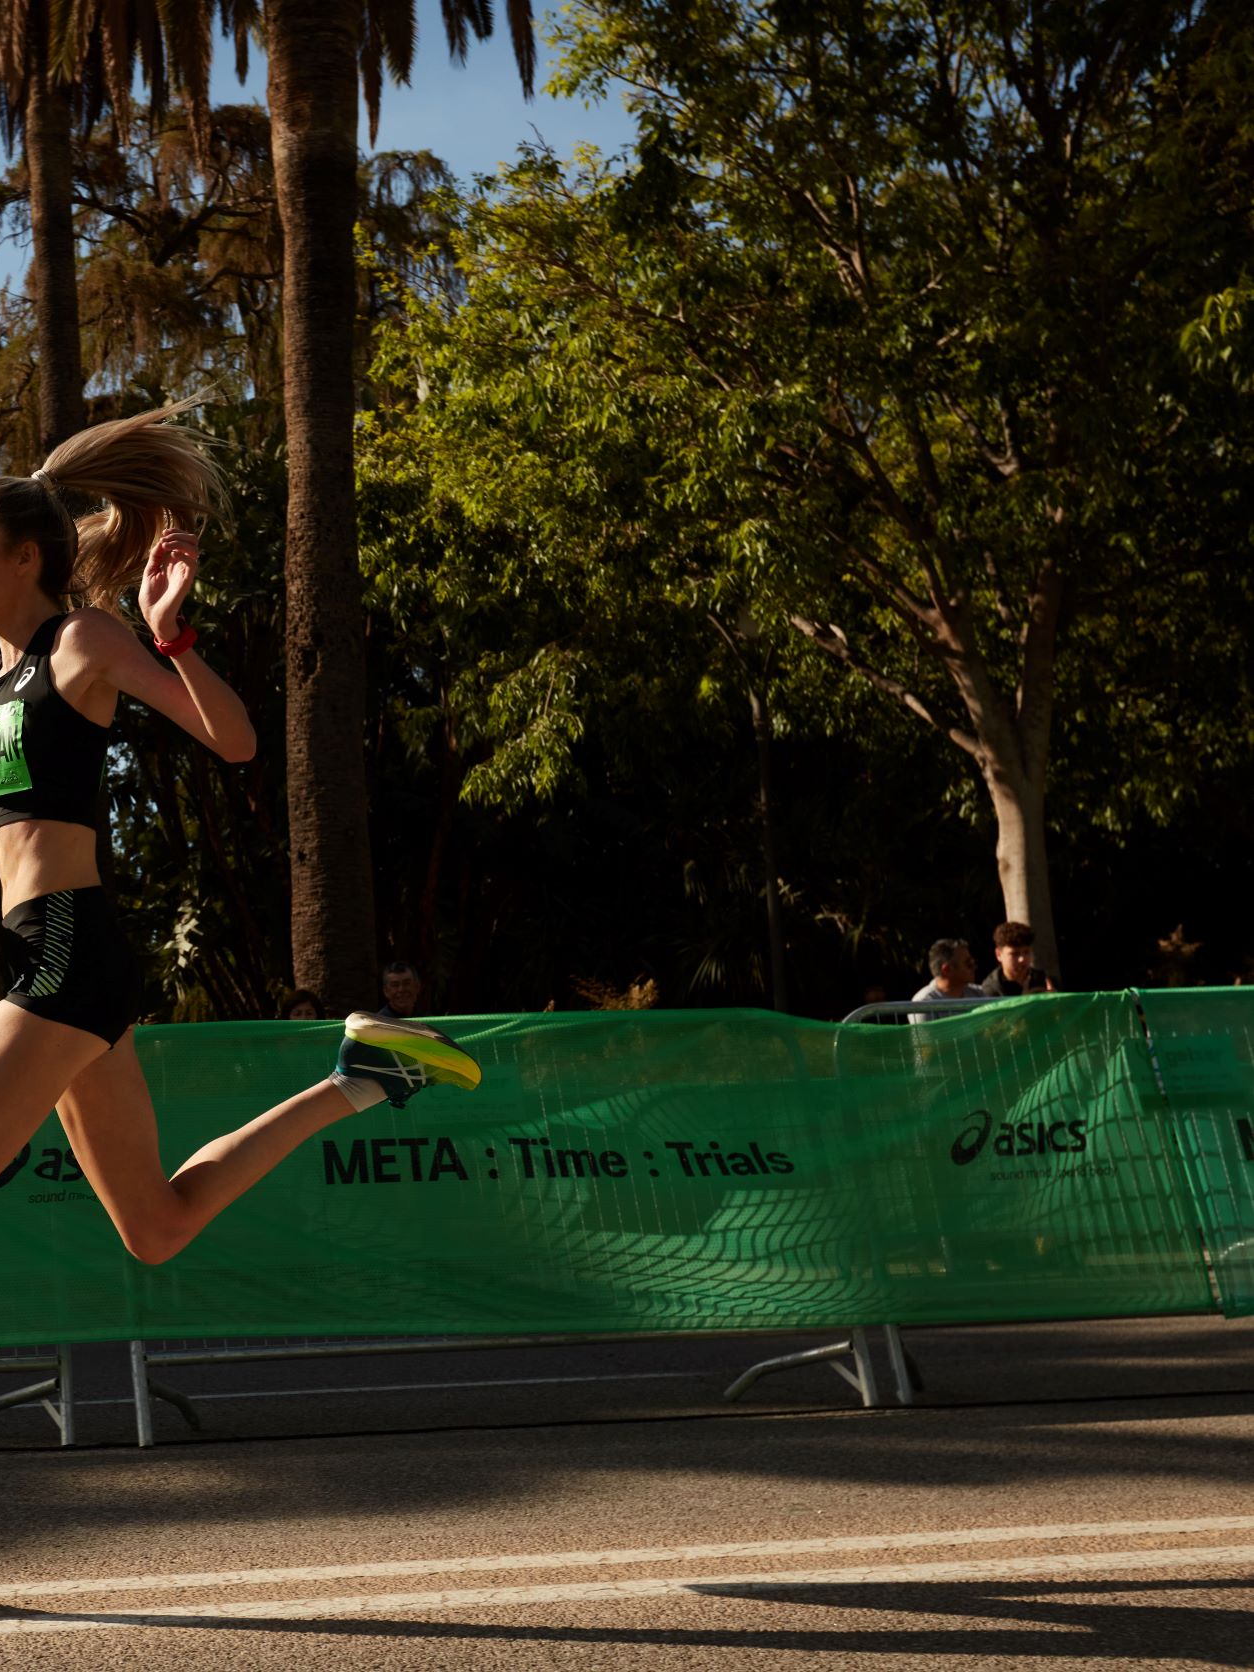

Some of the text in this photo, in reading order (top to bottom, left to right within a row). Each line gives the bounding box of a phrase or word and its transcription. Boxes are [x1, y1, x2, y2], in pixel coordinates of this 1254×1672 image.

[994, 1120, 1087, 1156] asics
[322, 1137, 795, 1184] META : Time : Trials
[28, 1189, 66, 1204] sound
